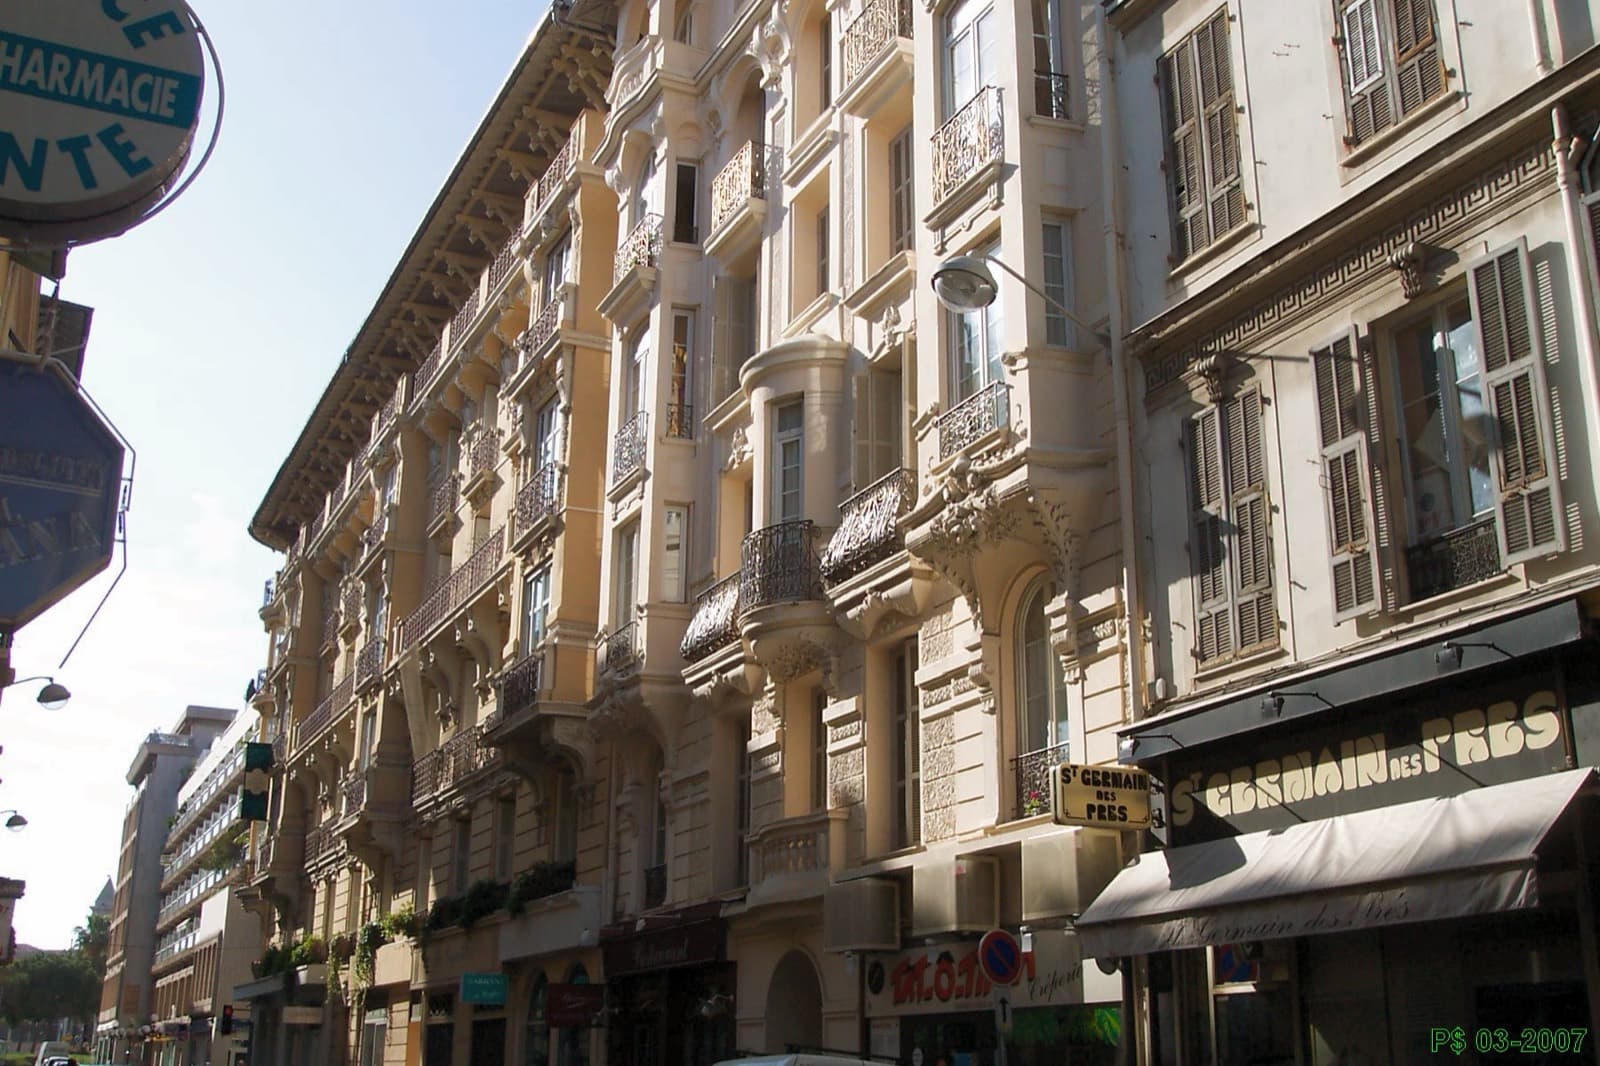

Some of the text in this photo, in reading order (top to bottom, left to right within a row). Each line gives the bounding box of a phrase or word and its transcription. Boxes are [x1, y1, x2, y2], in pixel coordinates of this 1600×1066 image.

[1081, 768, 1147, 791] GERMAIN
[1206, 733, 1388, 818] GERMAIN
[1389, 753, 1423, 781] DES
[1096, 790, 1117, 802] DES
[1086, 803, 1128, 822] PRES
